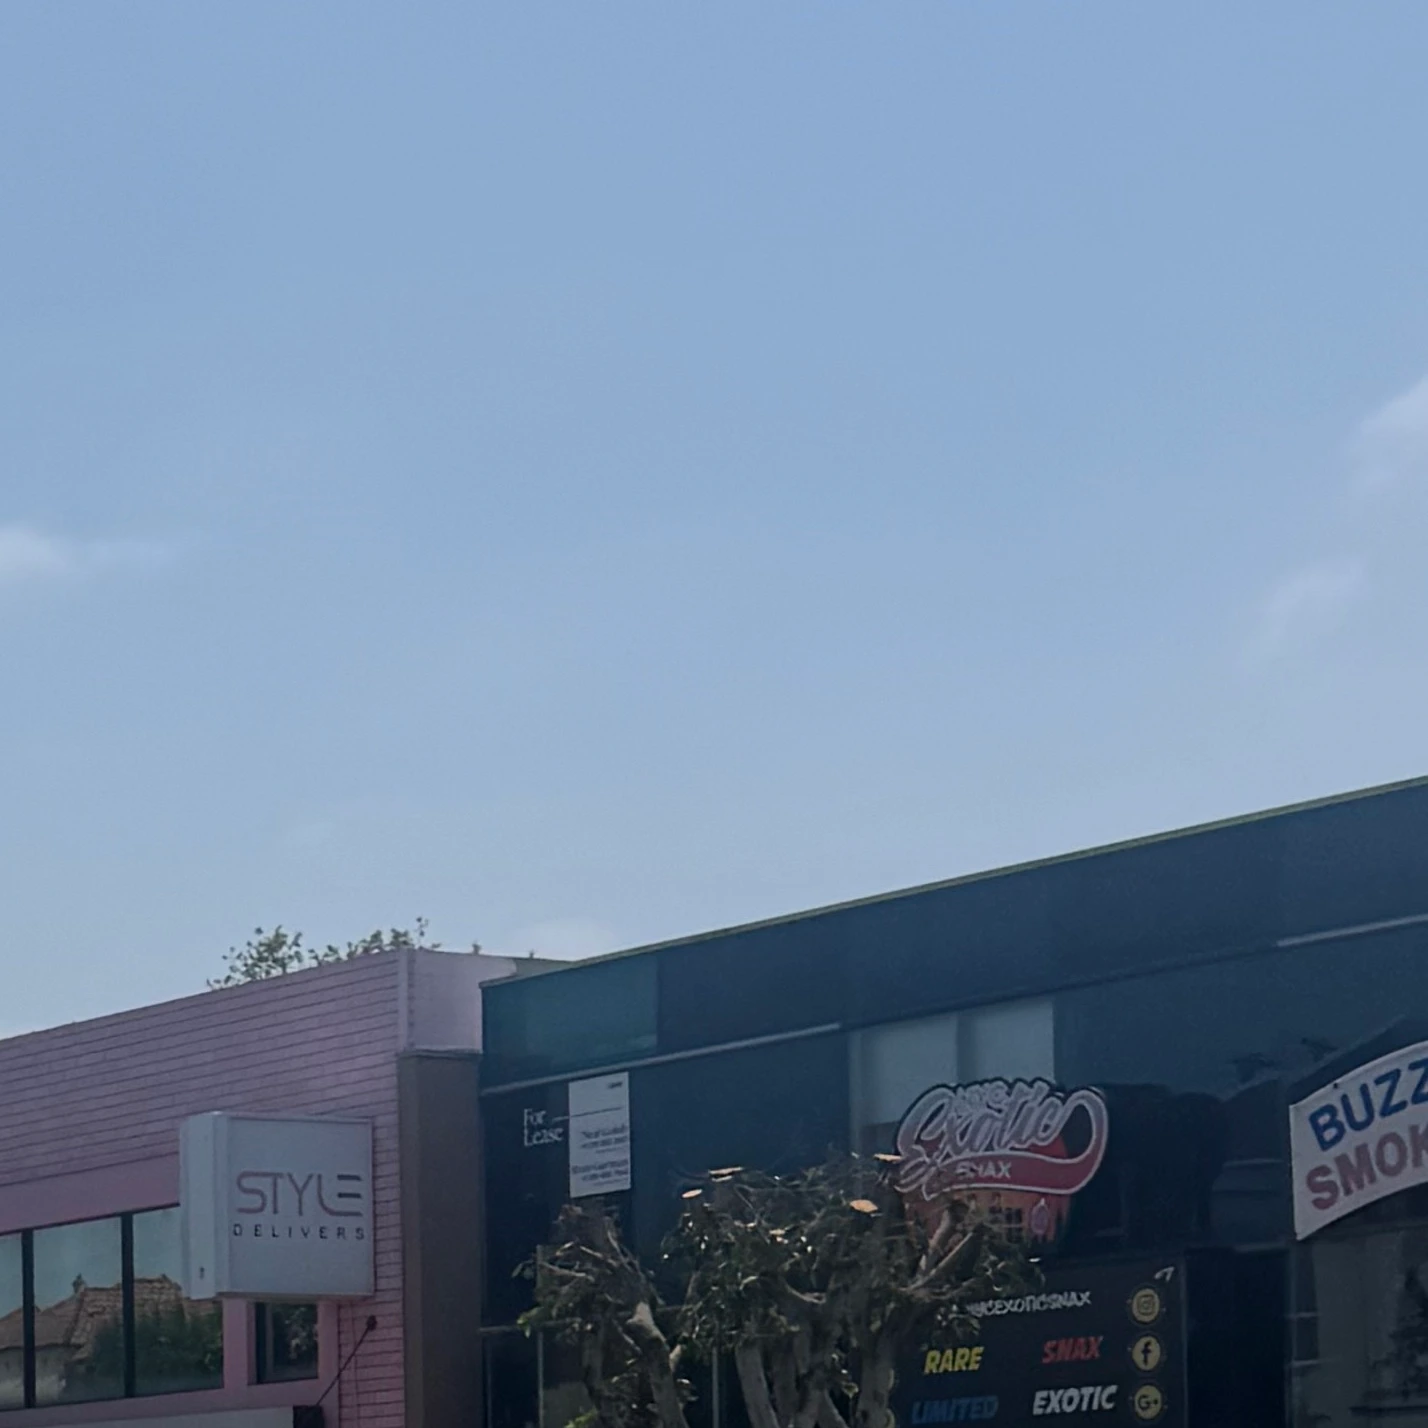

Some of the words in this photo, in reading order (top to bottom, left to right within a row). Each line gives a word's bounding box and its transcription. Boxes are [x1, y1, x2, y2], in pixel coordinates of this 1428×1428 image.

[524, 1107, 546, 1126] For
[524, 1126, 564, 1147] Lease
[236, 1170, 363, 1216] STYLE
[232, 1223, 365, 1241] DELIVERS
[923, 1346, 985, 1376] RARE
[1042, 1336, 1104, 1364] SNAX
[911, 1396, 999, 1425] LIMITED
[1032, 1385, 1119, 1416] EXOTIC
